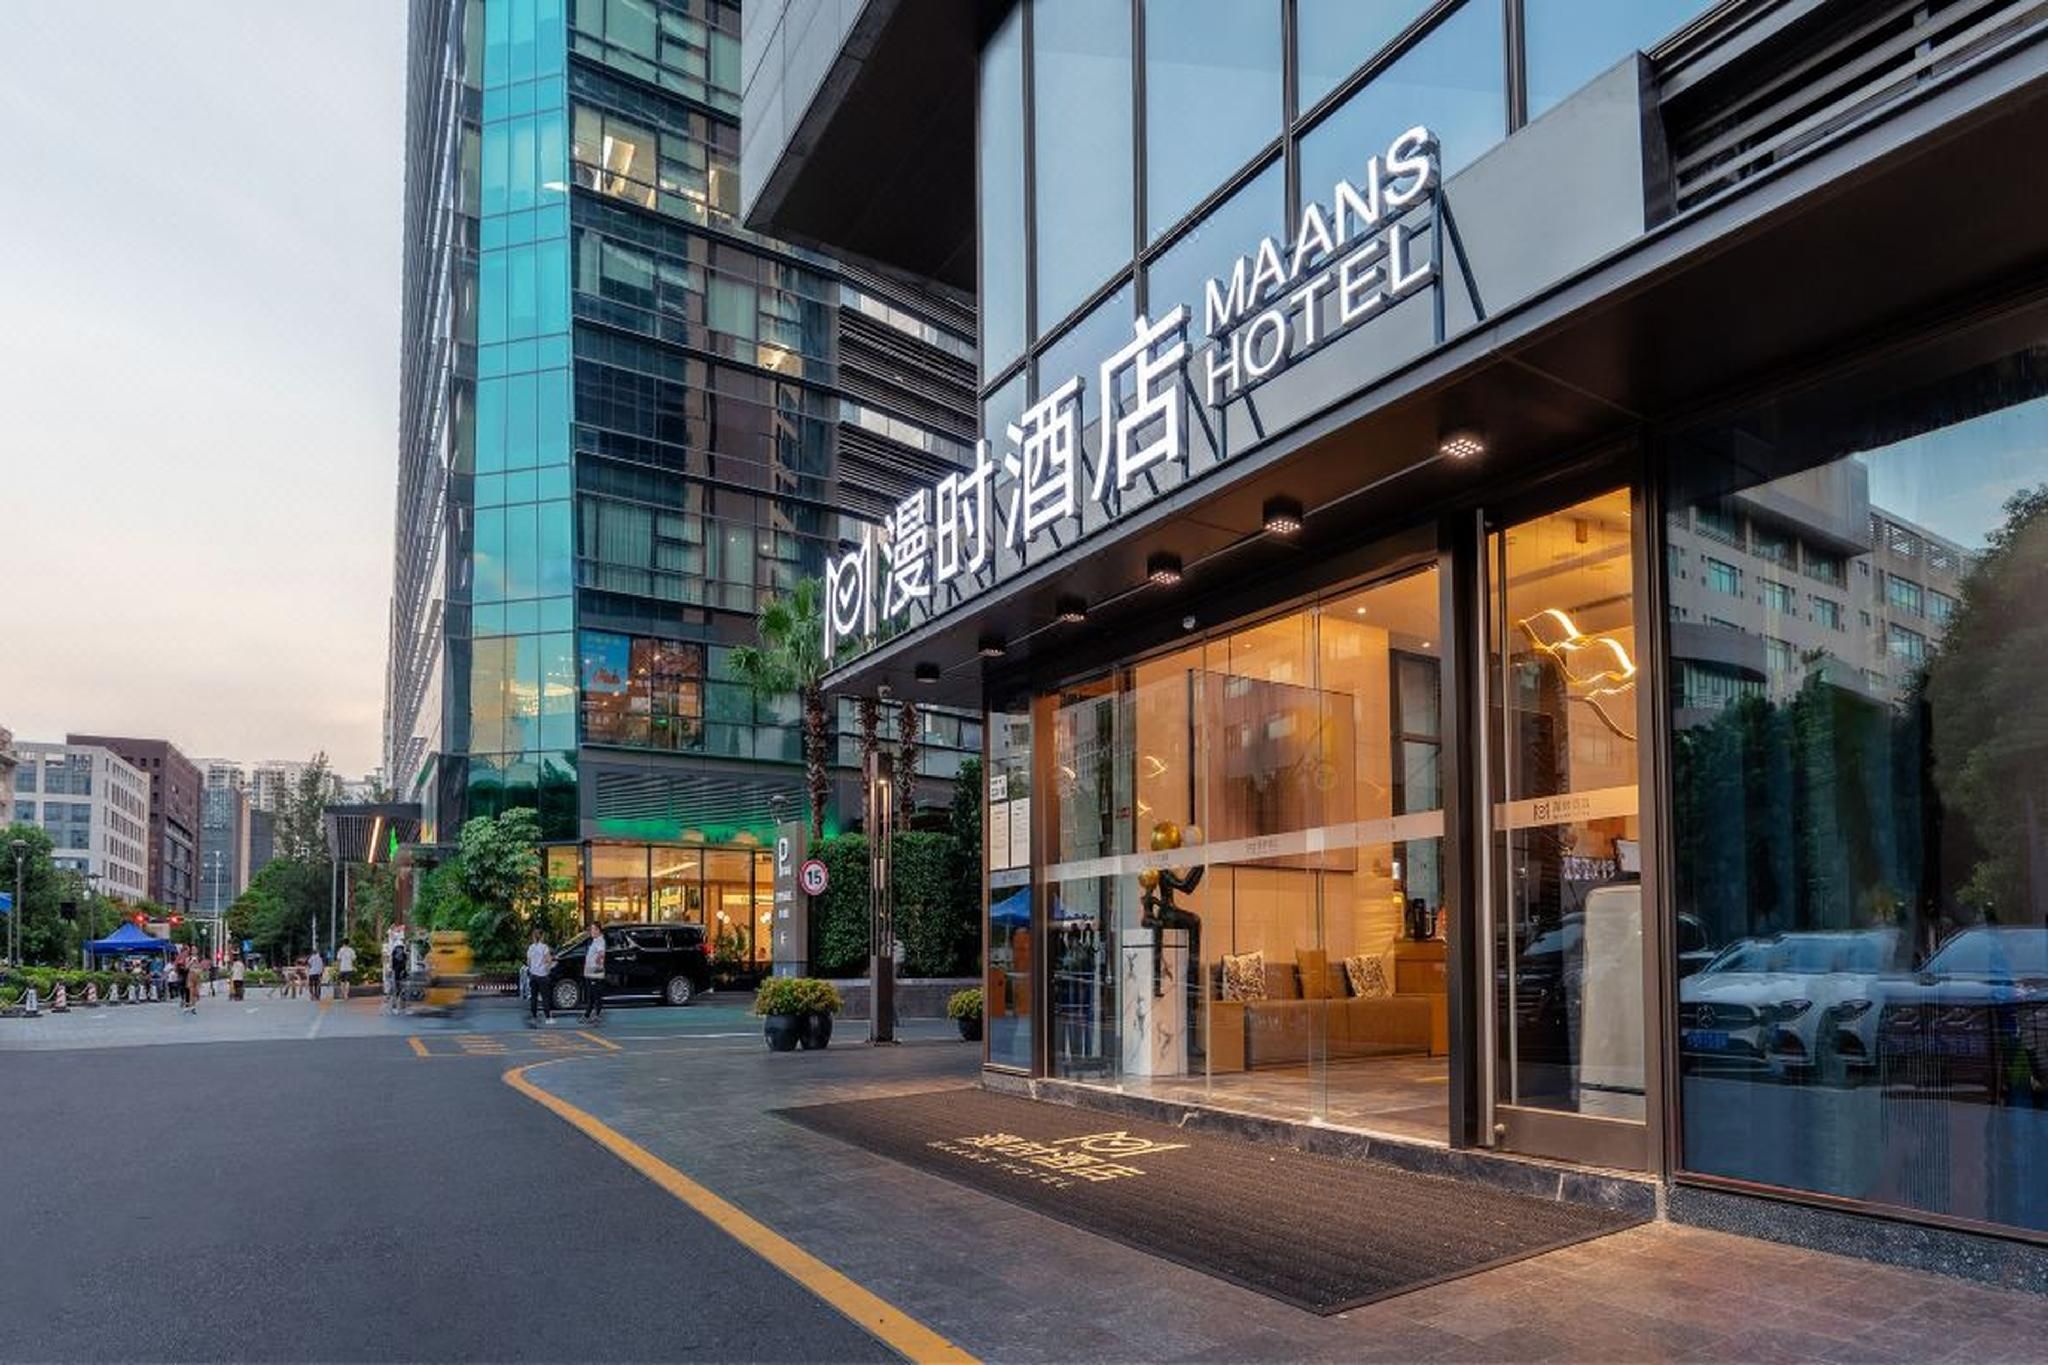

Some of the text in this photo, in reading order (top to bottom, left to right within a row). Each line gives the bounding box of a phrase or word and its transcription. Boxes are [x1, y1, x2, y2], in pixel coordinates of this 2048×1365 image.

[1206, 125, 1436, 338] MAANS
[1206, 224, 1434, 407] HOTEL
[883, 304, 1188, 620] 漫时酒店
[807, 869, 822, 885] 15
